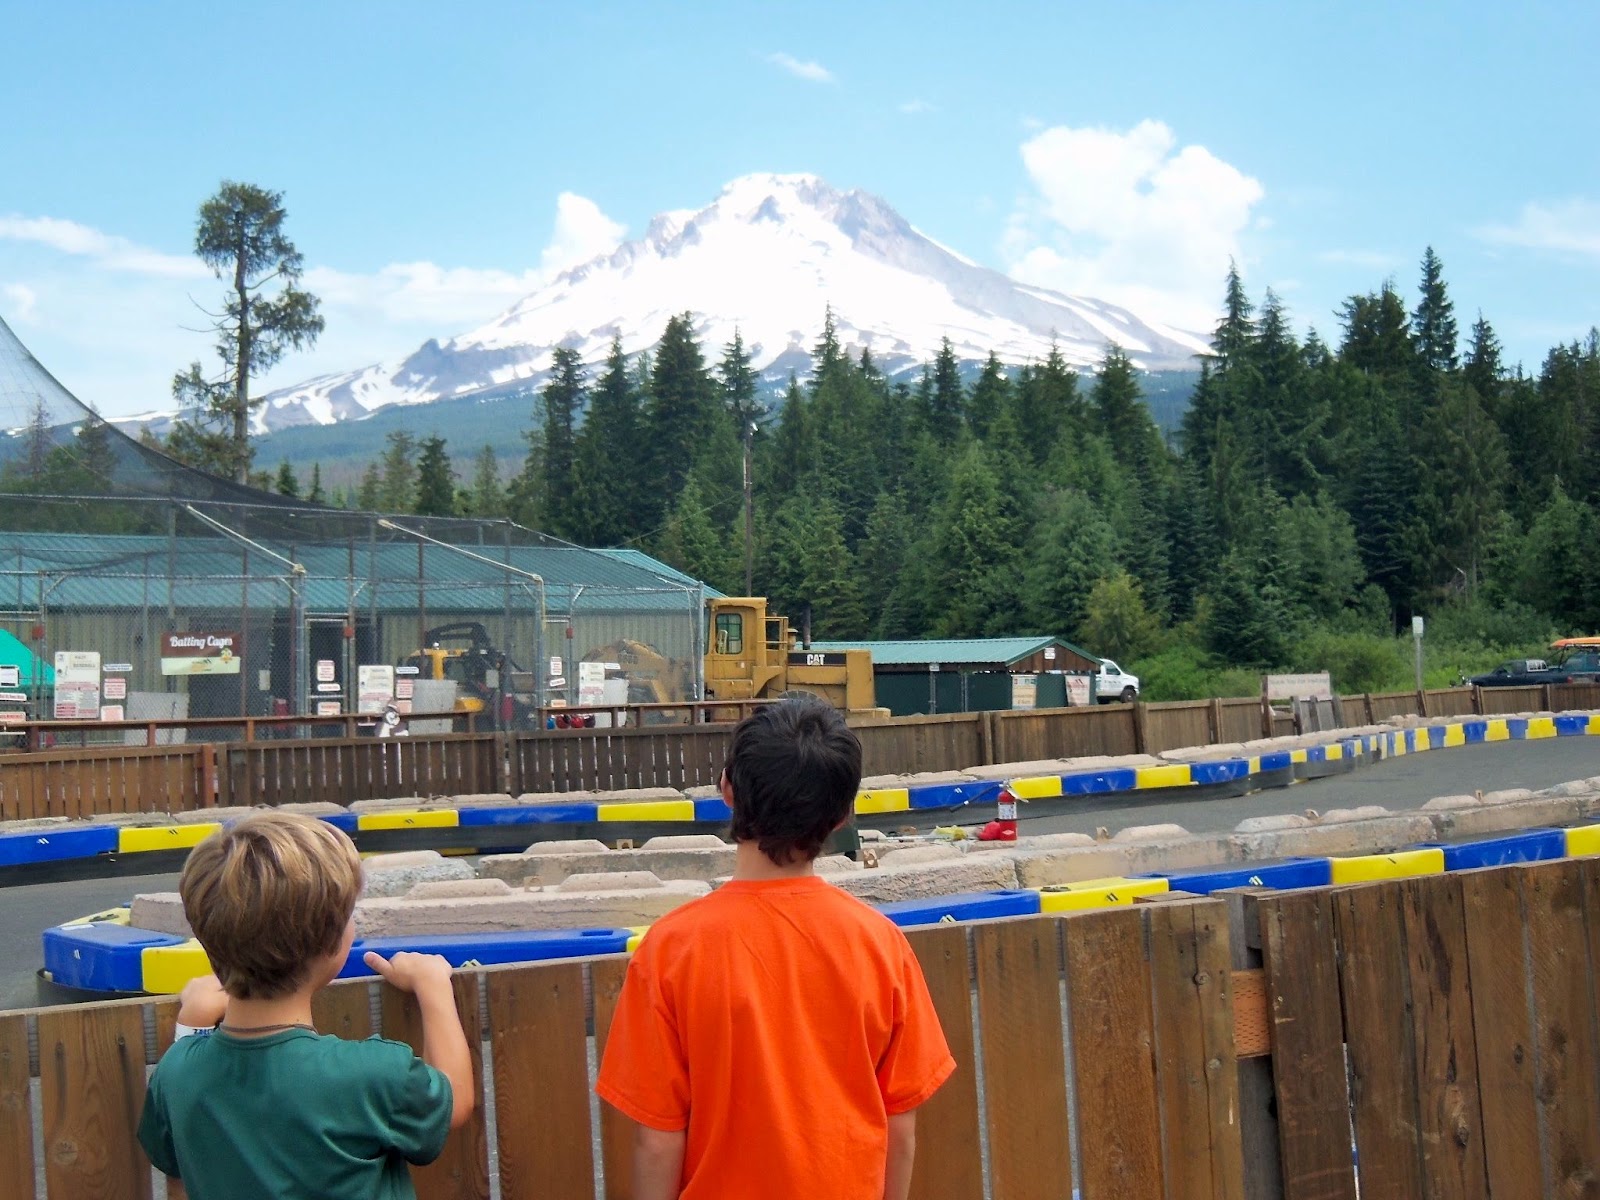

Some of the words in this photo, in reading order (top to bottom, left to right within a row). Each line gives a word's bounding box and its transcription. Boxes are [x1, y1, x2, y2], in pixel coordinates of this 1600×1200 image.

[169, 635, 206, 650] Batting
[207, 635, 233, 649] Cages
[806, 653, 826, 666] CAT
